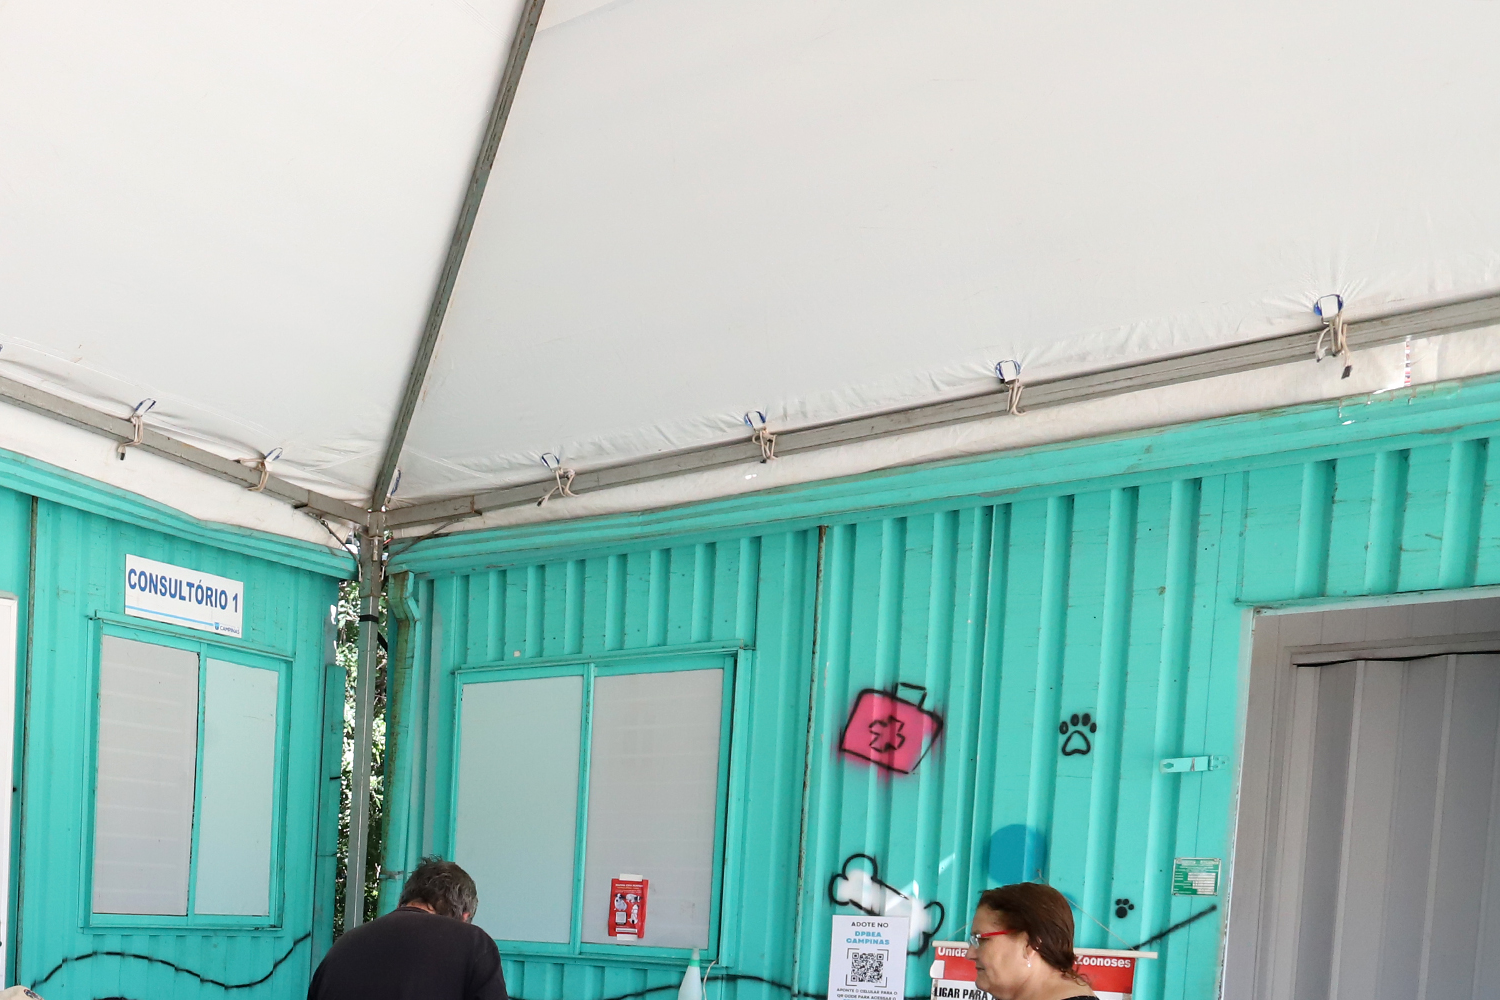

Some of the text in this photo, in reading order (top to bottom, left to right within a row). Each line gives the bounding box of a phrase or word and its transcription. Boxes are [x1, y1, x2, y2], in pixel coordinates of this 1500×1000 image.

[128, 568, 238, 613] CONSULTÓRIO 1
[1074, 955, 1131, 968] Zoonoses
[934, 986, 960, 999] LIGAR
[962, 989, 988, 1000] PARA
